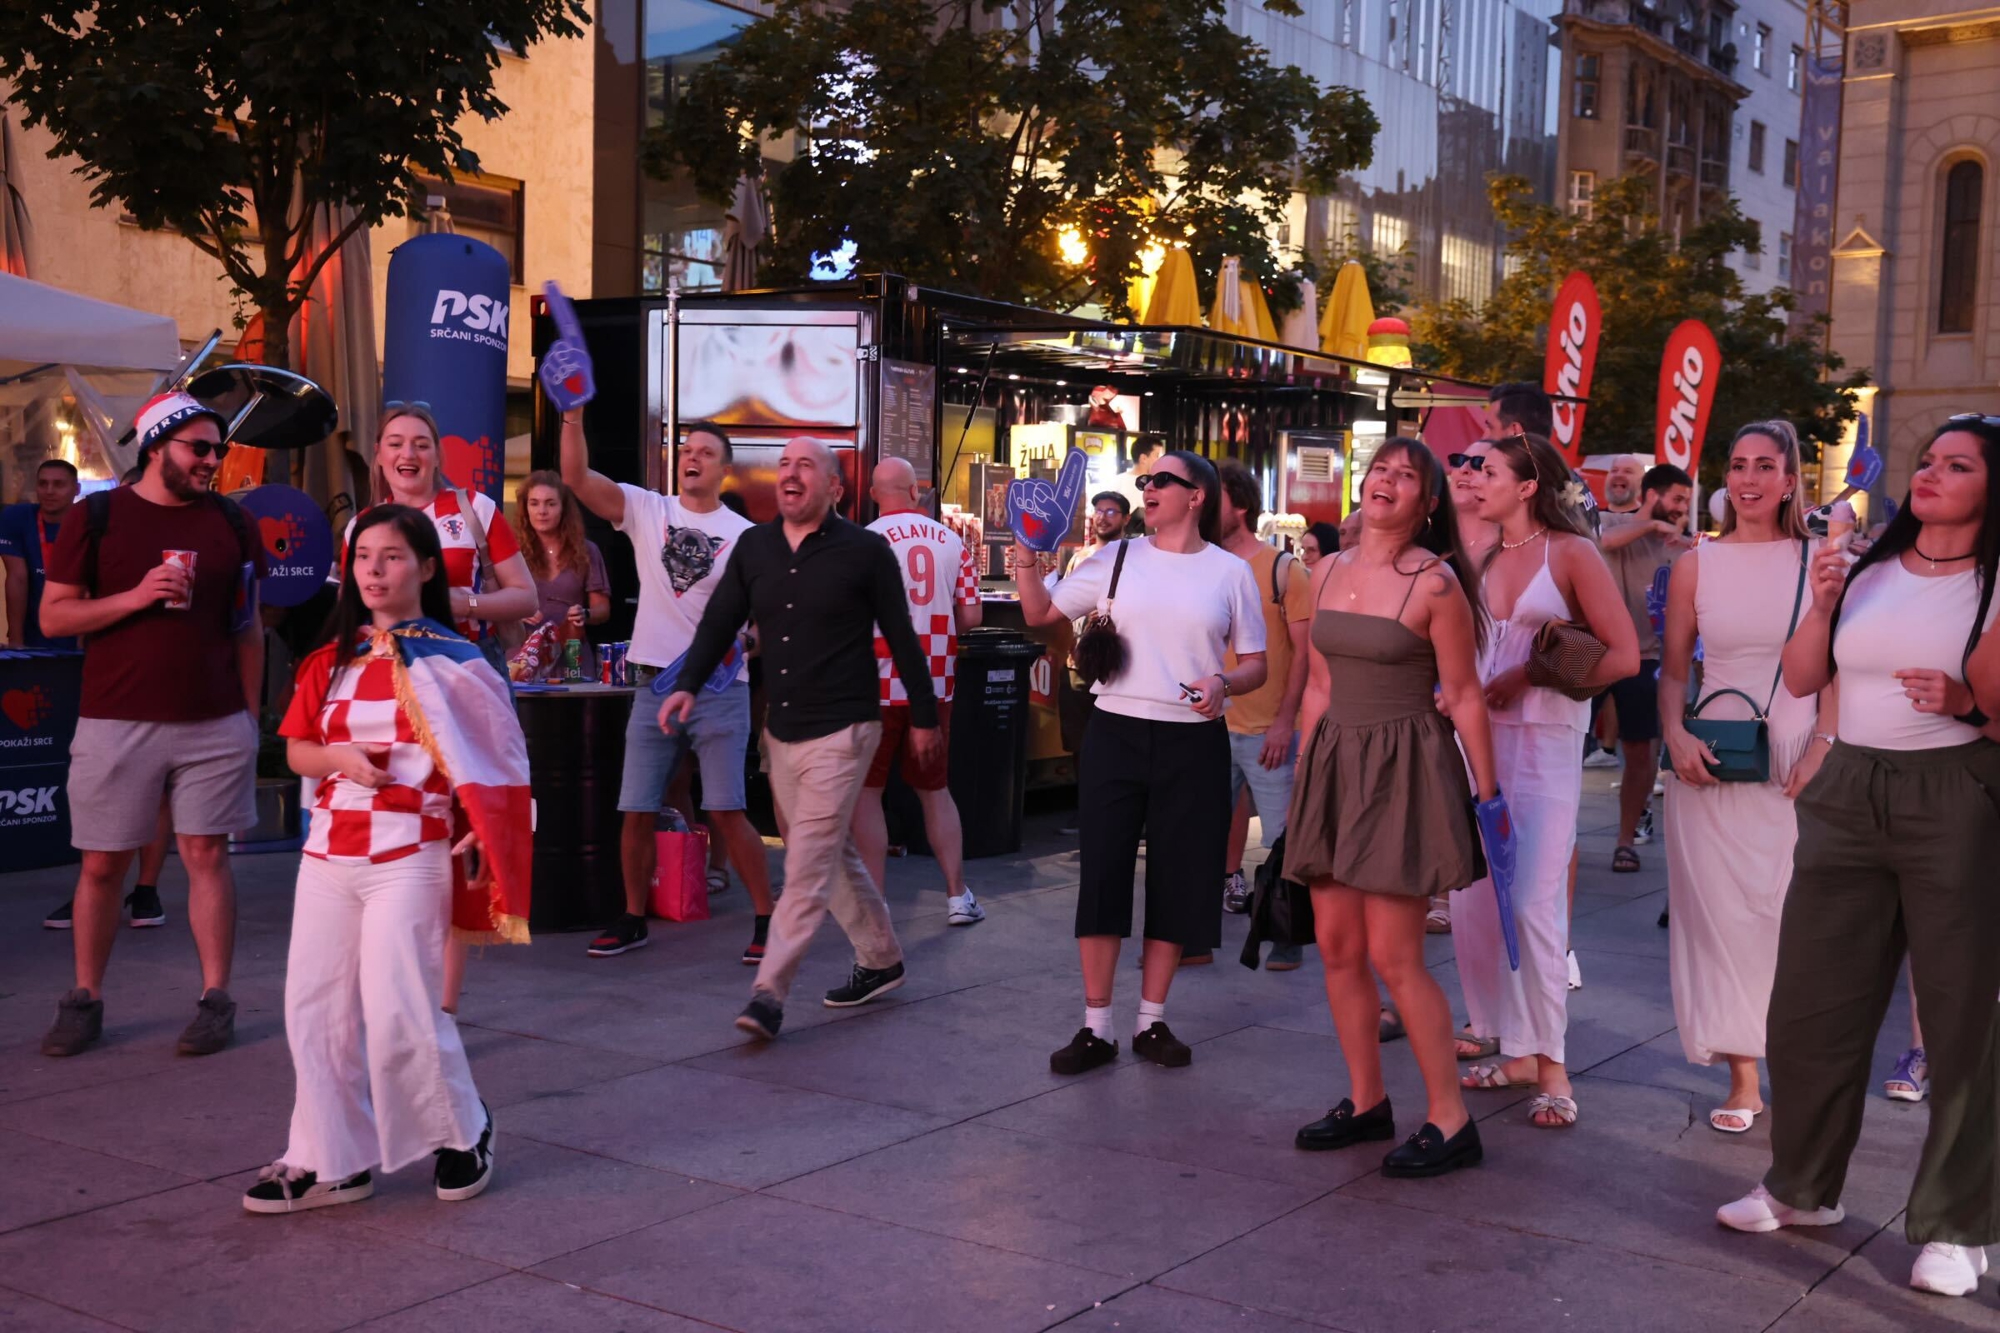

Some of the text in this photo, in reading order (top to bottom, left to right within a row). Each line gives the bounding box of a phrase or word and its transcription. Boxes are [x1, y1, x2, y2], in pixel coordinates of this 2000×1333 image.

[430, 289, 509, 339] PSK
[430, 327, 471, 341] SRČANI
[1552, 301, 1587, 445] Chio
[1663, 345, 1704, 471] Chio
[290, 566, 314, 576] SRCE
[907, 544, 935, 606] 9
[0, 736, 53, 748] POKAŽI SRCE
[0, 786, 59, 815] PSK
[0, 814, 57, 827] ČANI SPONZOR
